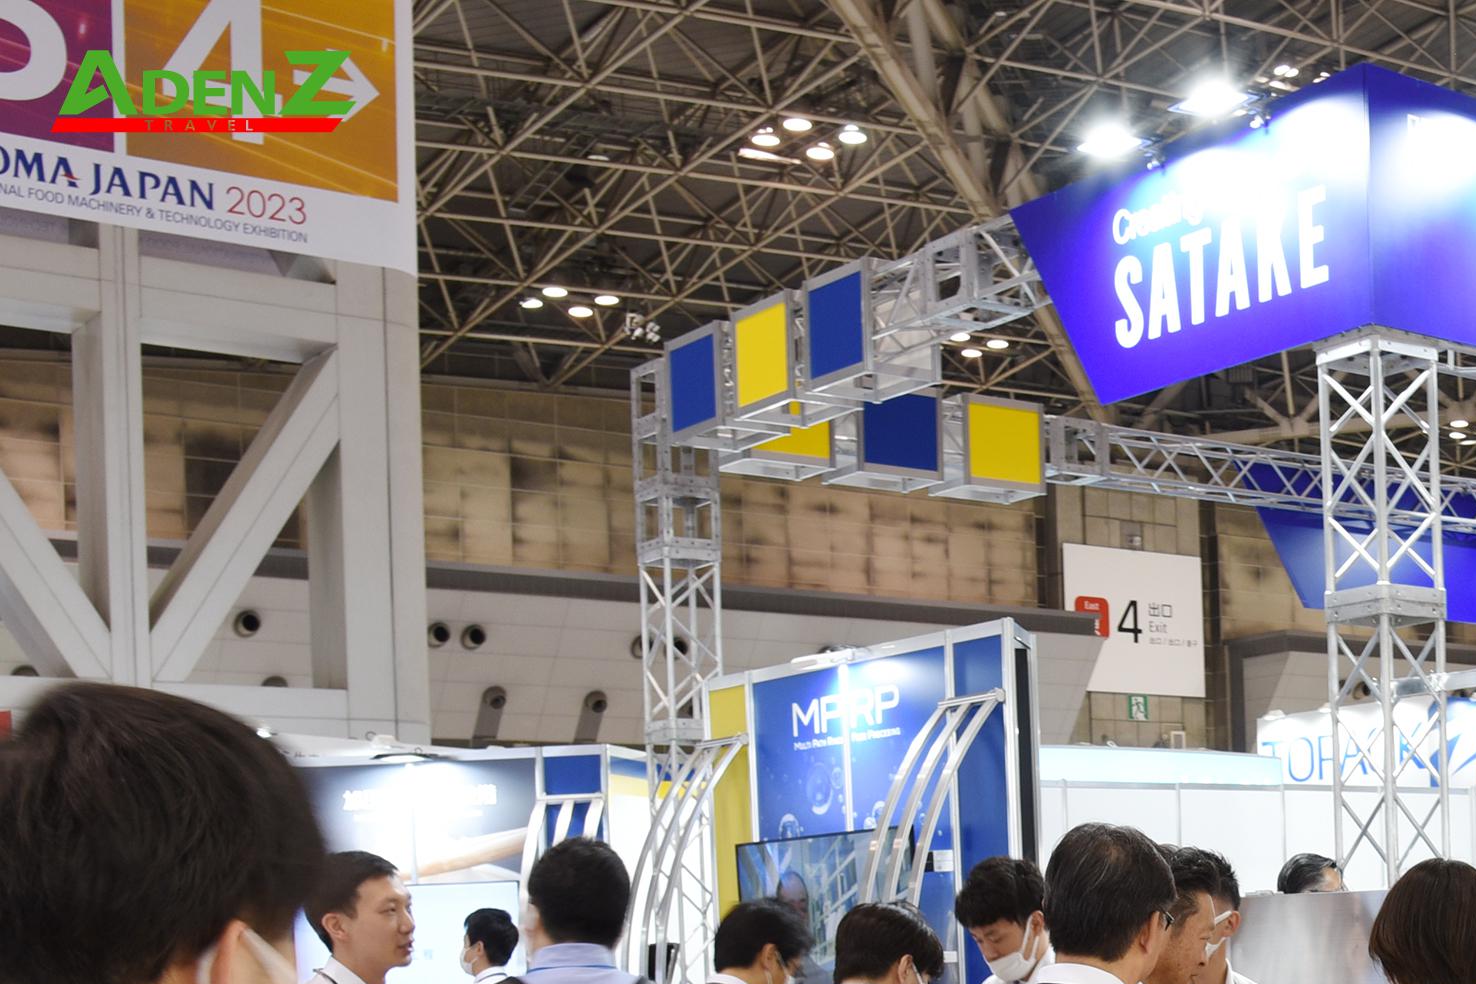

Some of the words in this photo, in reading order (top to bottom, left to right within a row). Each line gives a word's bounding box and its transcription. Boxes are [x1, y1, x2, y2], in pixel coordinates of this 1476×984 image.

[27, 187, 64, 205] FOOD
[67, 193, 142, 219] MACHINERY
[145, 207, 155, 219] &
[157, 208, 243, 232] TECHNOLOGY
[242, 222, 309, 244] EXHIBITION
[89, 162, 215, 211] JAPAN
[225, 186, 308, 225] 2023
[1113, 184, 1330, 349] SATAKE
[1117, 599, 1142, 644] 4
[1148, 602, 1173, 618] 出口
[1148, 620, 1168, 634] Exit
